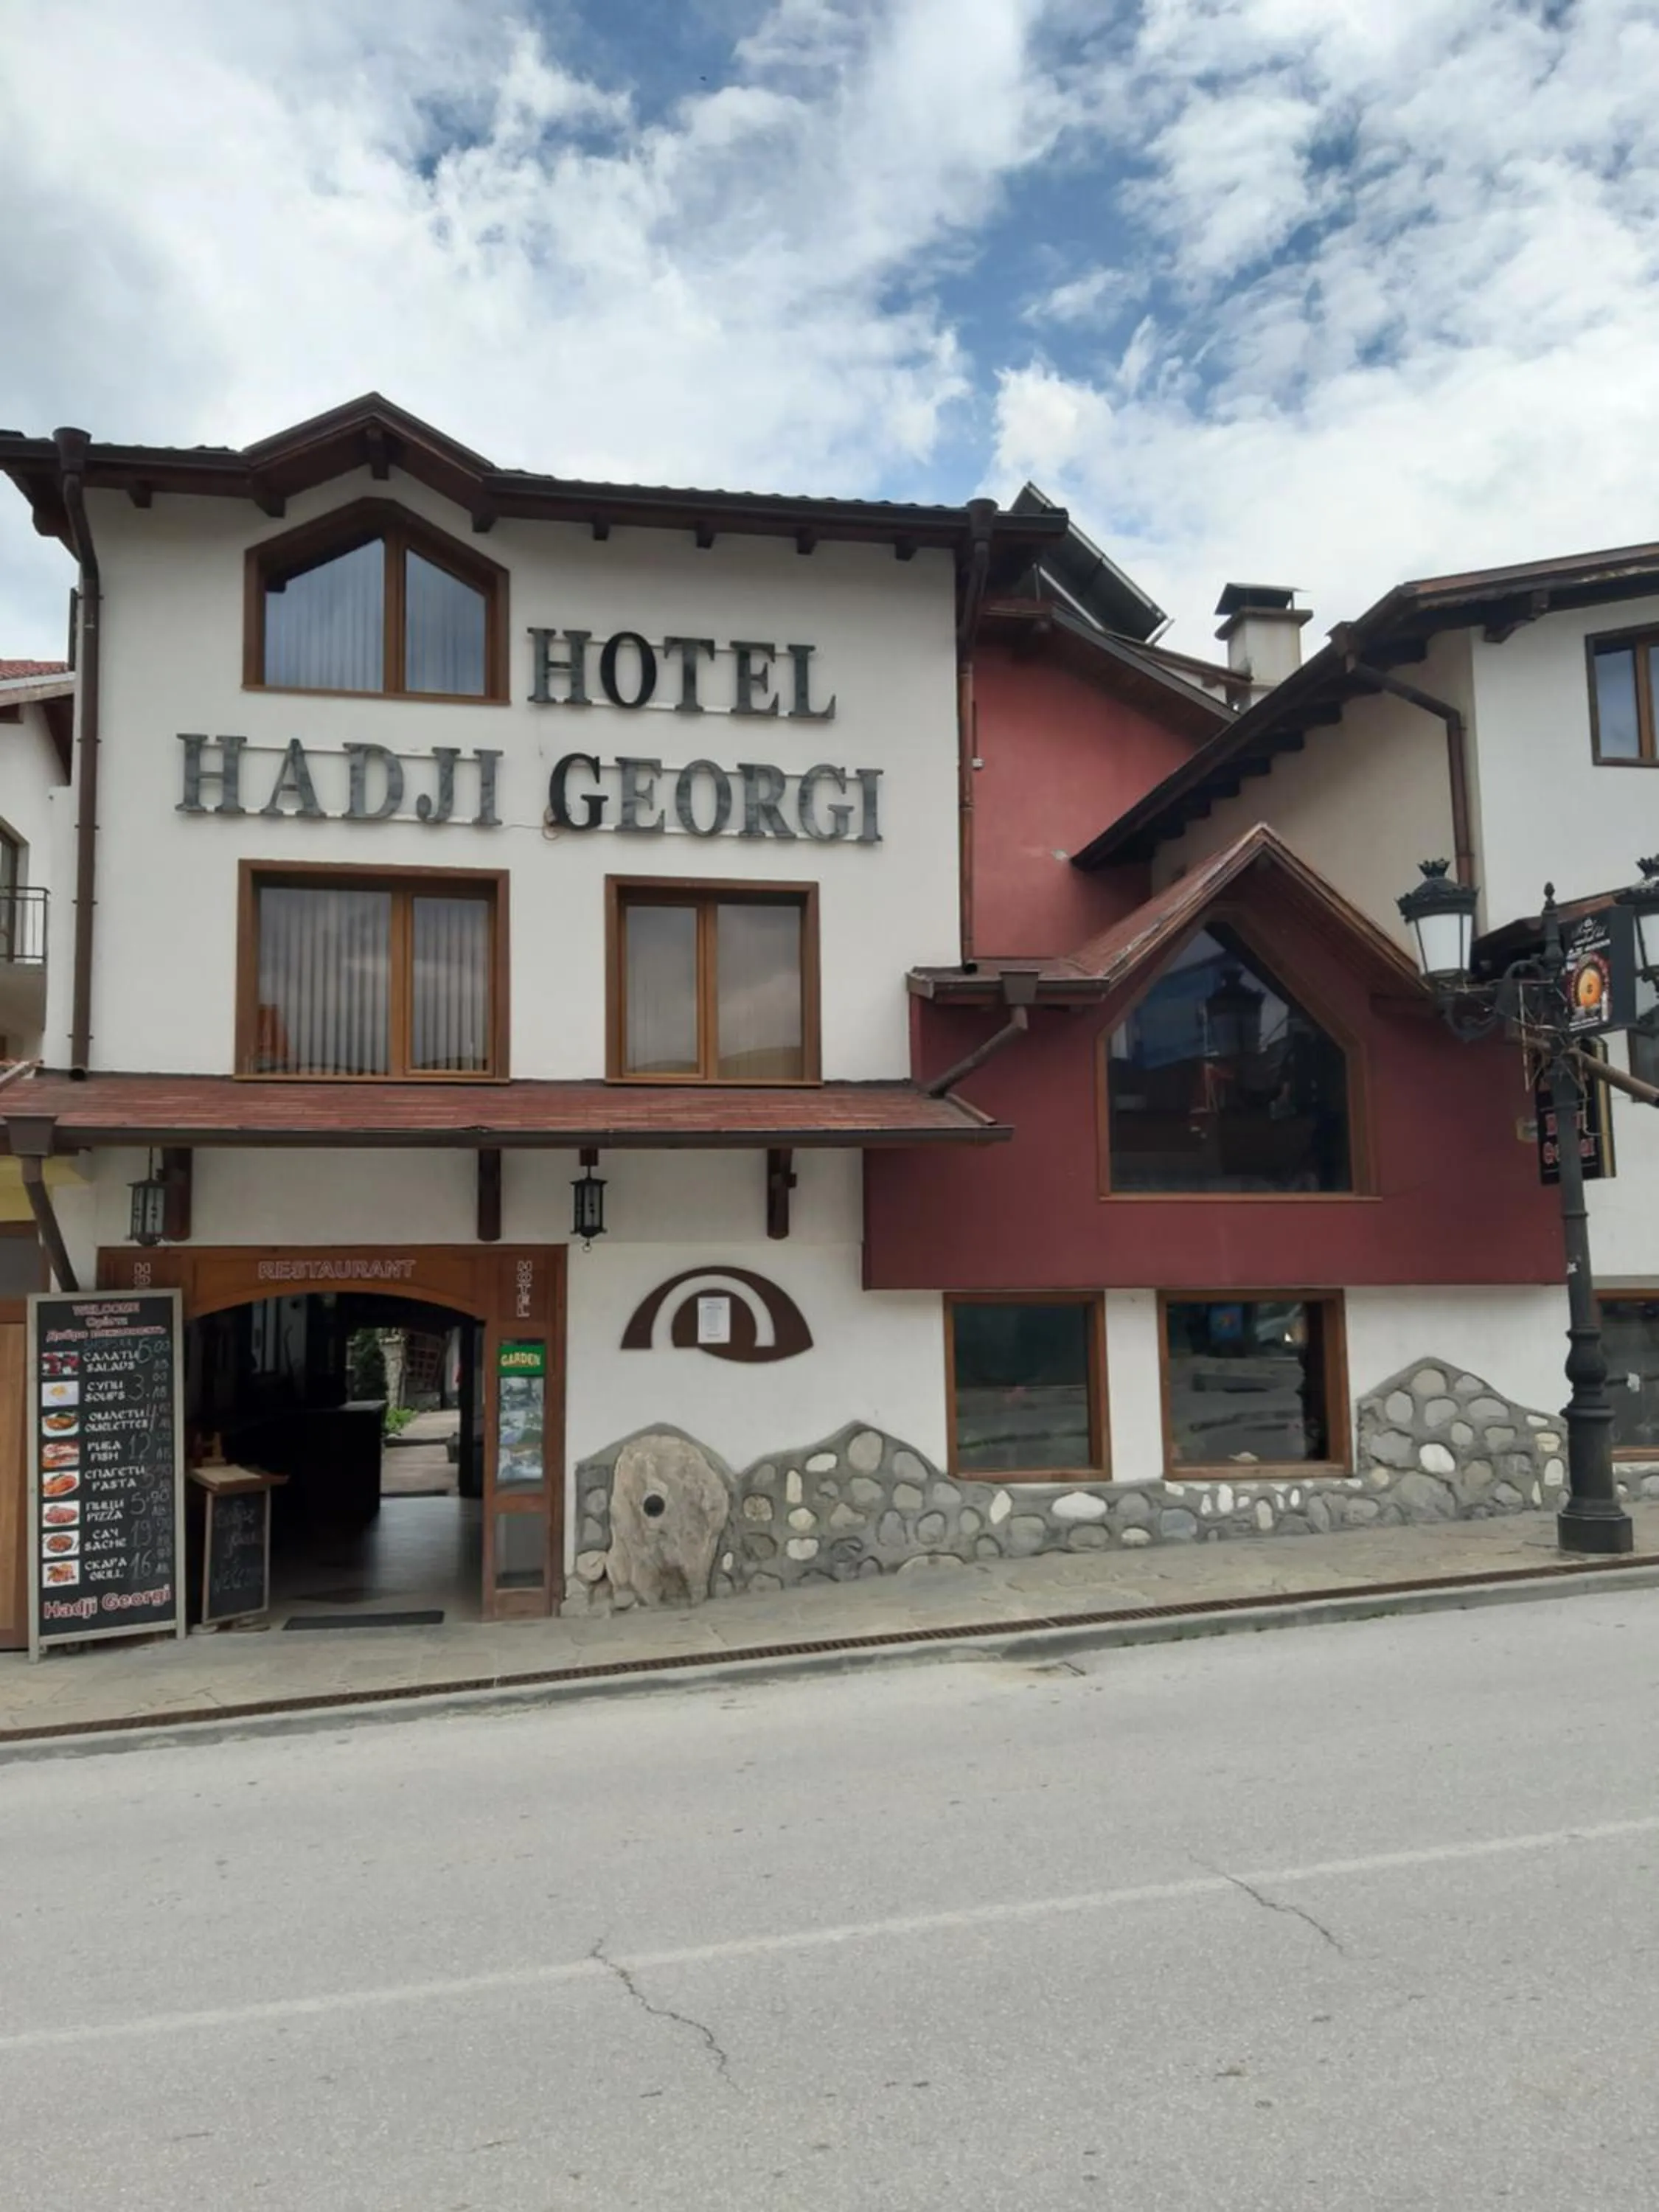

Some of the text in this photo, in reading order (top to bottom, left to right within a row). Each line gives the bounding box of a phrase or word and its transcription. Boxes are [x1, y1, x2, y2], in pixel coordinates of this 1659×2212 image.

[526, 627, 835, 719] HOTEL
[175, 733, 884, 843] HADJI GEORGI
[258, 1259, 417, 1280] RESTAURANT
[517, 1260, 532, 1318] HOTEL
[83, 1351, 138, 1362] САЛАТИ
[501, 1352, 541, 1367] GARDEN
[86, 1361, 135, 1373] SALADS
[87, 1380, 123, 1391] СУПИ
[90, 1451, 119, 1462] FISH
[84, 1465, 145, 1479] СПАГЕТИ
[91, 1477, 136, 1492] PASTA
[86, 1509, 123, 1523] PIZZA
[92, 1527, 119, 1540] САЧ
[84, 1537, 127, 1551] SACHE
[84, 1557, 128, 1571] СКАРА
[44, 1584, 172, 1619] Hadji Georgi
